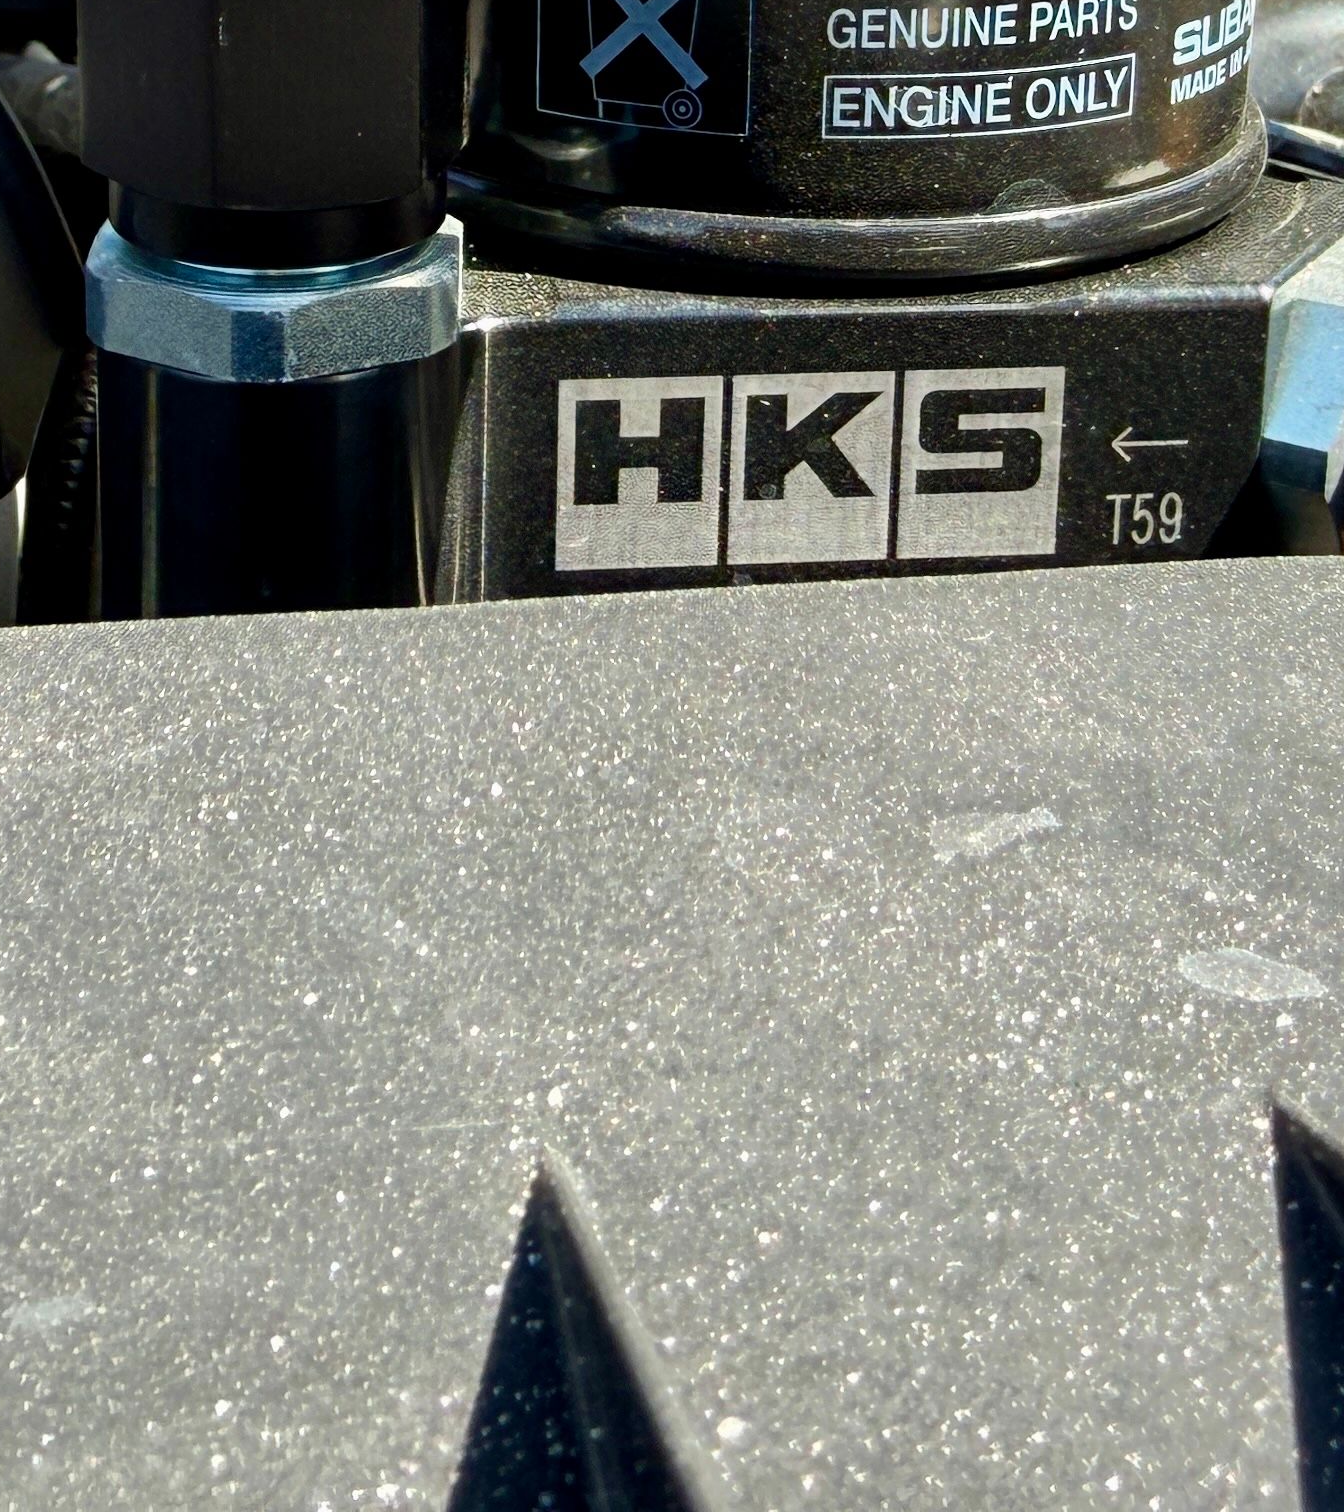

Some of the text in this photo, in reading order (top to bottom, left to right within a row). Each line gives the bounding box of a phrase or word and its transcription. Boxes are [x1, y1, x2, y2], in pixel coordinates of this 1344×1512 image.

[826, 3, 1019, 50] GENUINE
[831, 66, 1129, 128] ENGINE ONLY
[1170, 57, 1227, 105] MADE
[1229, 46, 1244, 78] IN
[572, 386, 1047, 506] HKS
[1105, 491, 1184, 546] T59
